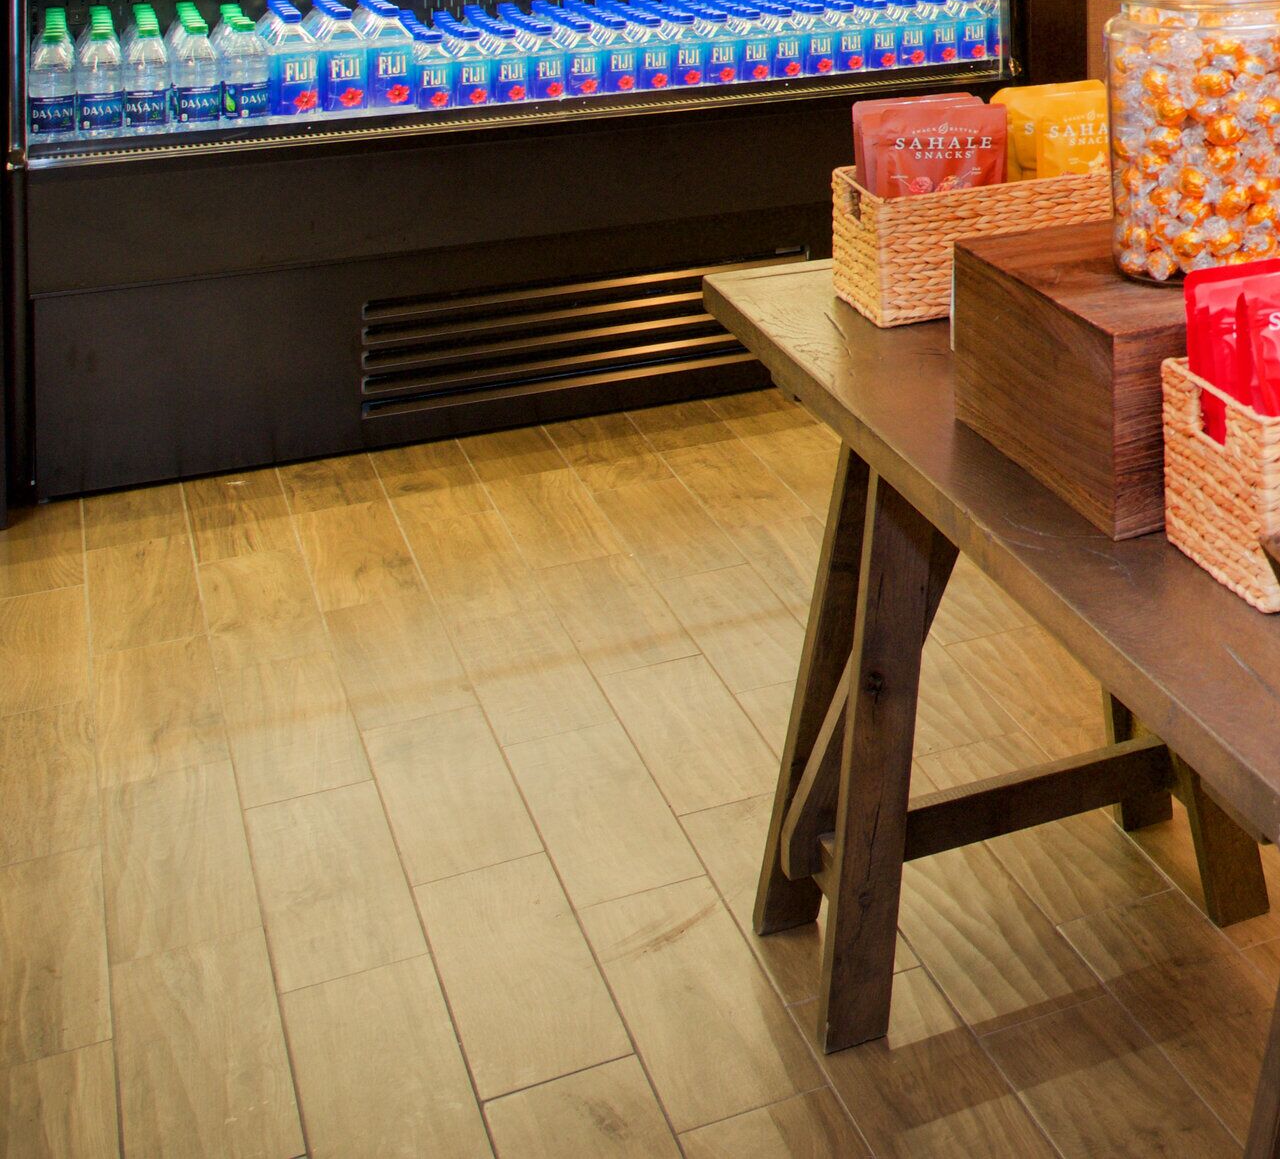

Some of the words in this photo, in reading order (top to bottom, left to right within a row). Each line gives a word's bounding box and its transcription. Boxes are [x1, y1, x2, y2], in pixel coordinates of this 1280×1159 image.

[903, 30, 923, 44] FIJI
[935, 27, 955, 42] FIJI
[965, 24, 984, 39] FIJI
[811, 38, 832, 52] FIJI
[841, 35, 861, 50] FIJI
[875, 33, 895, 47] FIJI
[712, 46, 735, 62] FIJI
[746, 44, 767, 59] FIJI
[778, 41, 799, 56] FIJI
[611, 54, 633, 71] FIJI
[645, 52, 667, 68] FIJI
[678, 49, 700, 65] FIJI
[285, 59, 316, 82] FIJI
[331, 58, 360, 78] FIJI
[378, 55, 407, 76] FIJI
[501, 63, 523, 80] FIJI
[539, 60, 561, 78] FIJI
[573, 57, 596, 73] FIJI
[423, 70, 447, 86] FIJI
[462, 67, 485, 83] FIJI
[32, 108, 73, 119] DASANI
[83, 105, 122, 116] DASANI
[126, 101, 164, 113] DASANI
[895, 137, 992, 150] SAHALE
[915, 151, 974, 160] SNACKS
